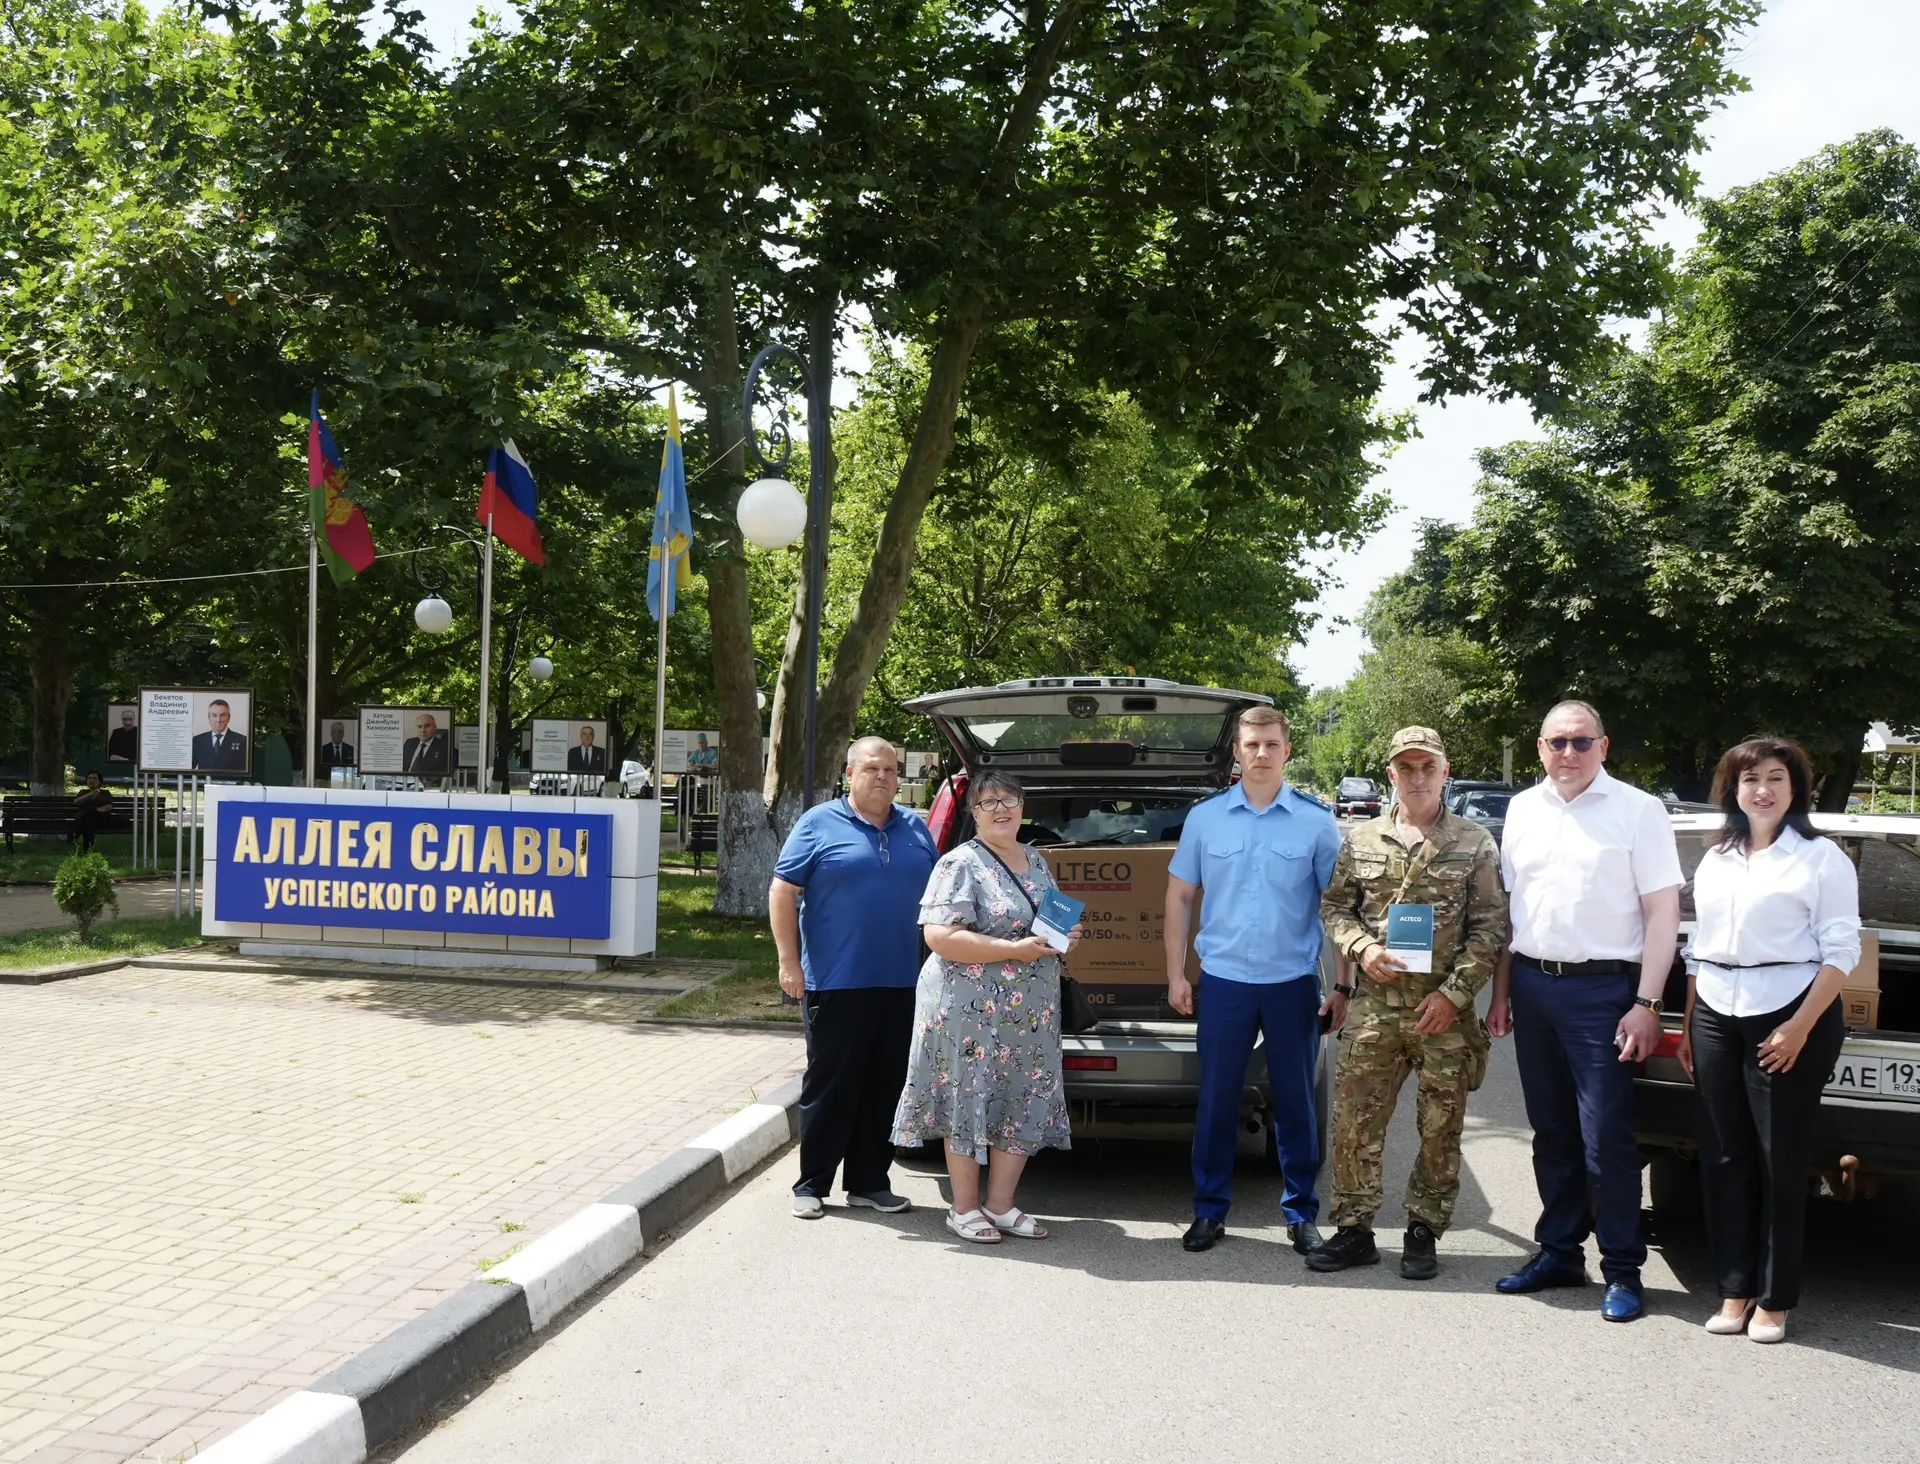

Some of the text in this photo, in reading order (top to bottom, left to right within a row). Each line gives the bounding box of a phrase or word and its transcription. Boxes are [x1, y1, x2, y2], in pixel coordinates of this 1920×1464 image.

[149, 701, 188, 709] Владимир
[233, 816, 589, 878] АЛЛЕЯ СЛАВЫ
[1056, 862, 1132, 881] LTECO
[264, 877, 555, 919] УСПЕНСКОГО РАЙОНА
[1052, 900, 1071, 912] ALTECO
[1893, 1083, 1917, 1094] RUS
